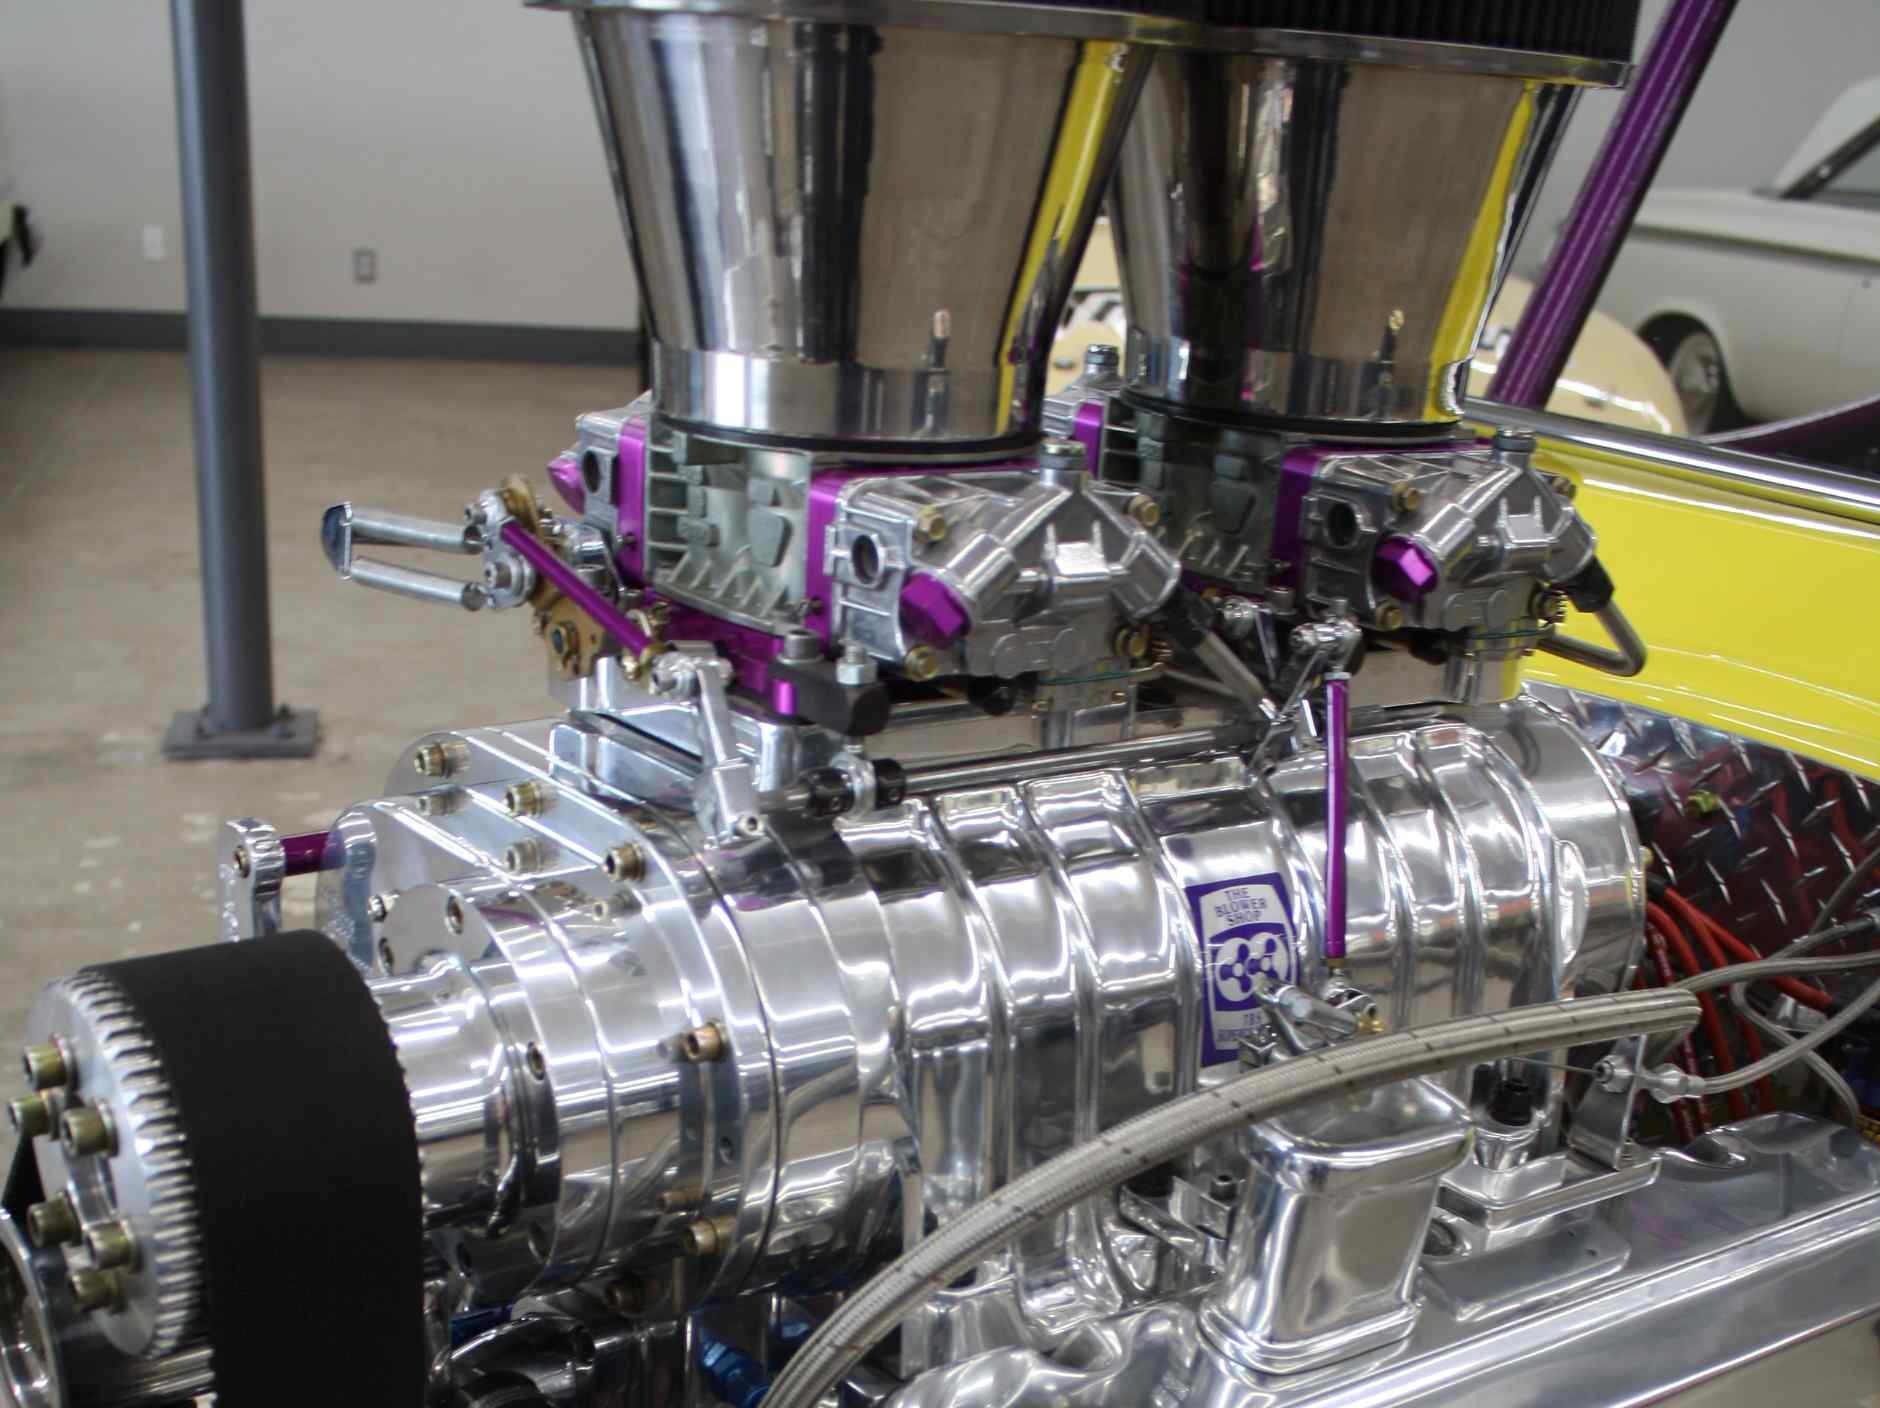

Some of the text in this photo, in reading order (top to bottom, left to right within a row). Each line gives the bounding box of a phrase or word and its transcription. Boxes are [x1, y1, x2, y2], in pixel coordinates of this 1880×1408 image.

[1223, 888, 1249, 901] THE
[1214, 898, 1267, 917] BLOWER
[1225, 910, 1262, 926] SHOP
